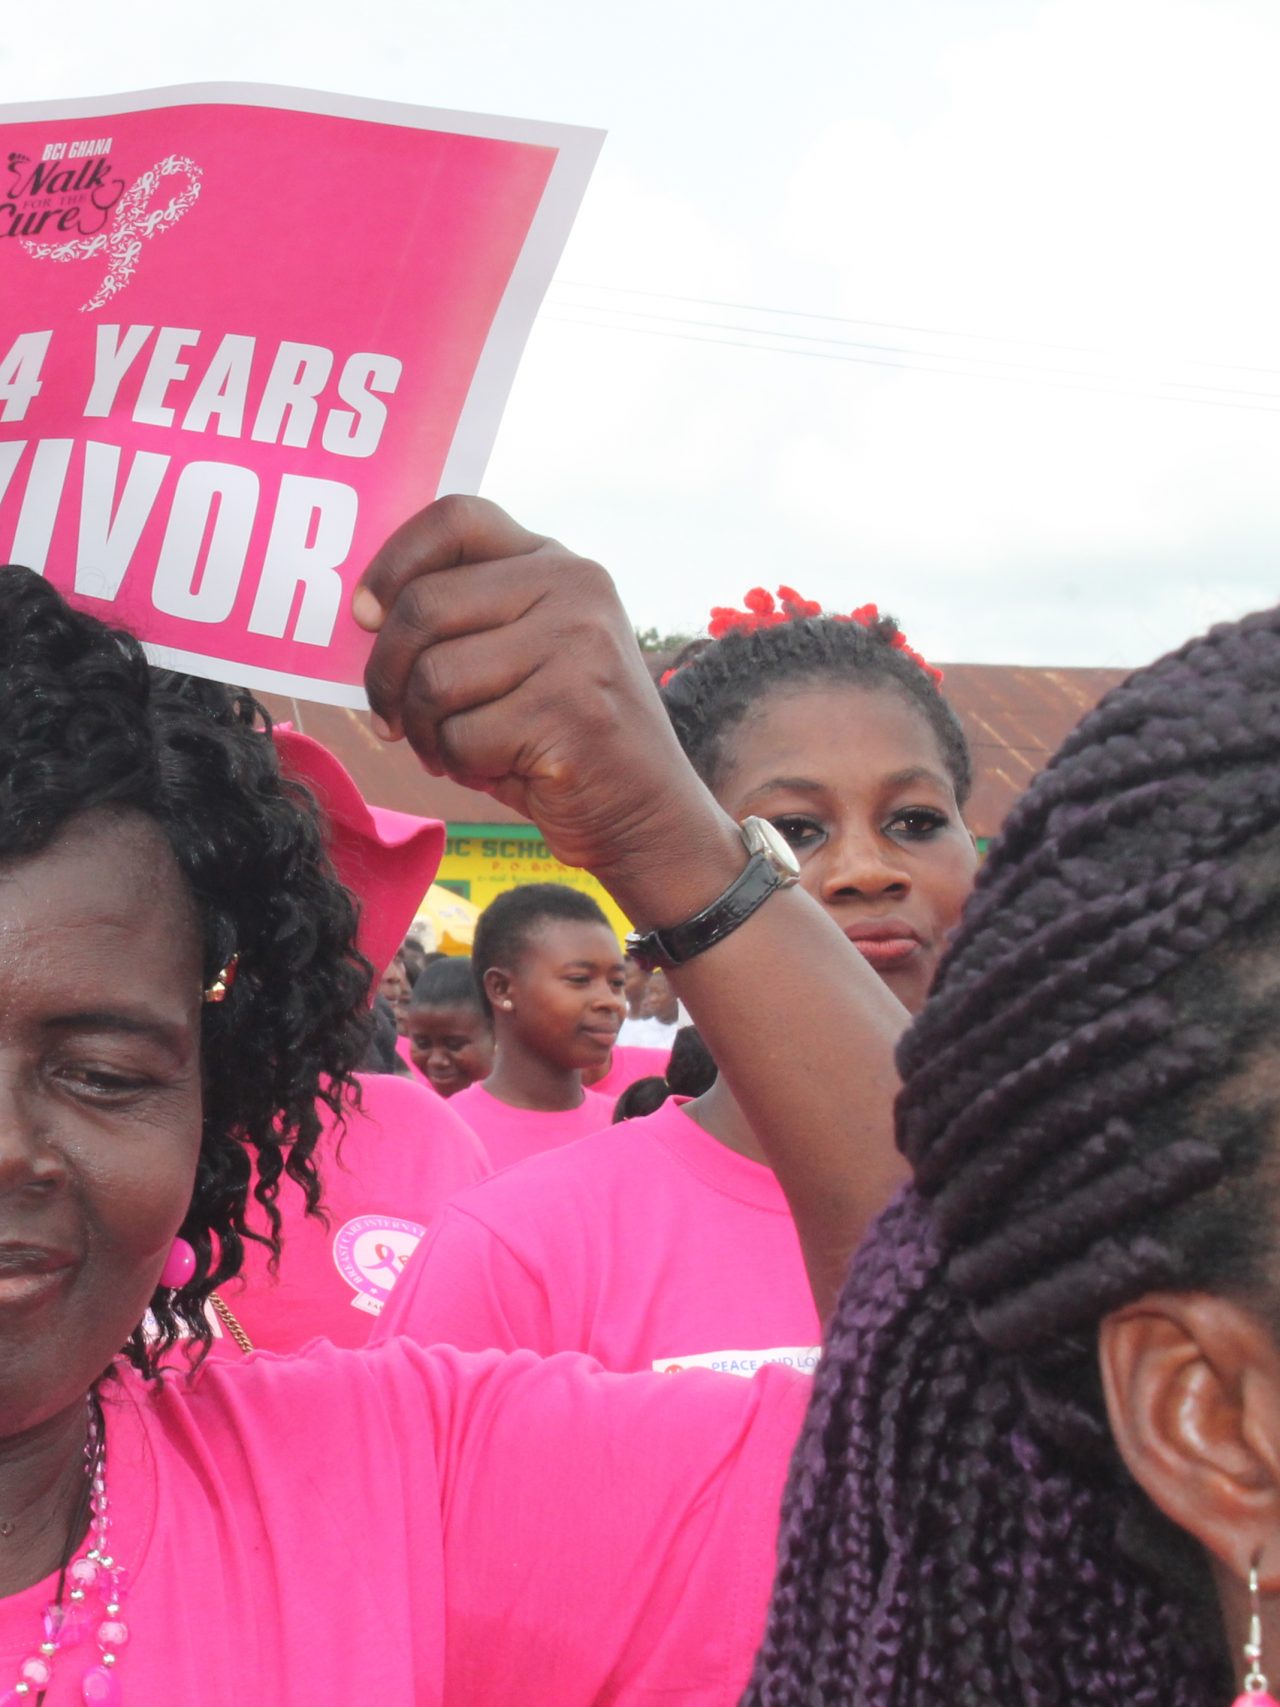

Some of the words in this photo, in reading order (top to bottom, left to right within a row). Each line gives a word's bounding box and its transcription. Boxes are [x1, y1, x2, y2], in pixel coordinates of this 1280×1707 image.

[41, 143, 67, 161] BCI
[68, 137, 113, 160] GHANA
[22, 198, 53, 210] FOR
[59, 194, 87, 205] THE
[82, 323, 403, 459] YEARS
[711, 1359, 758, 1373] PEACE
